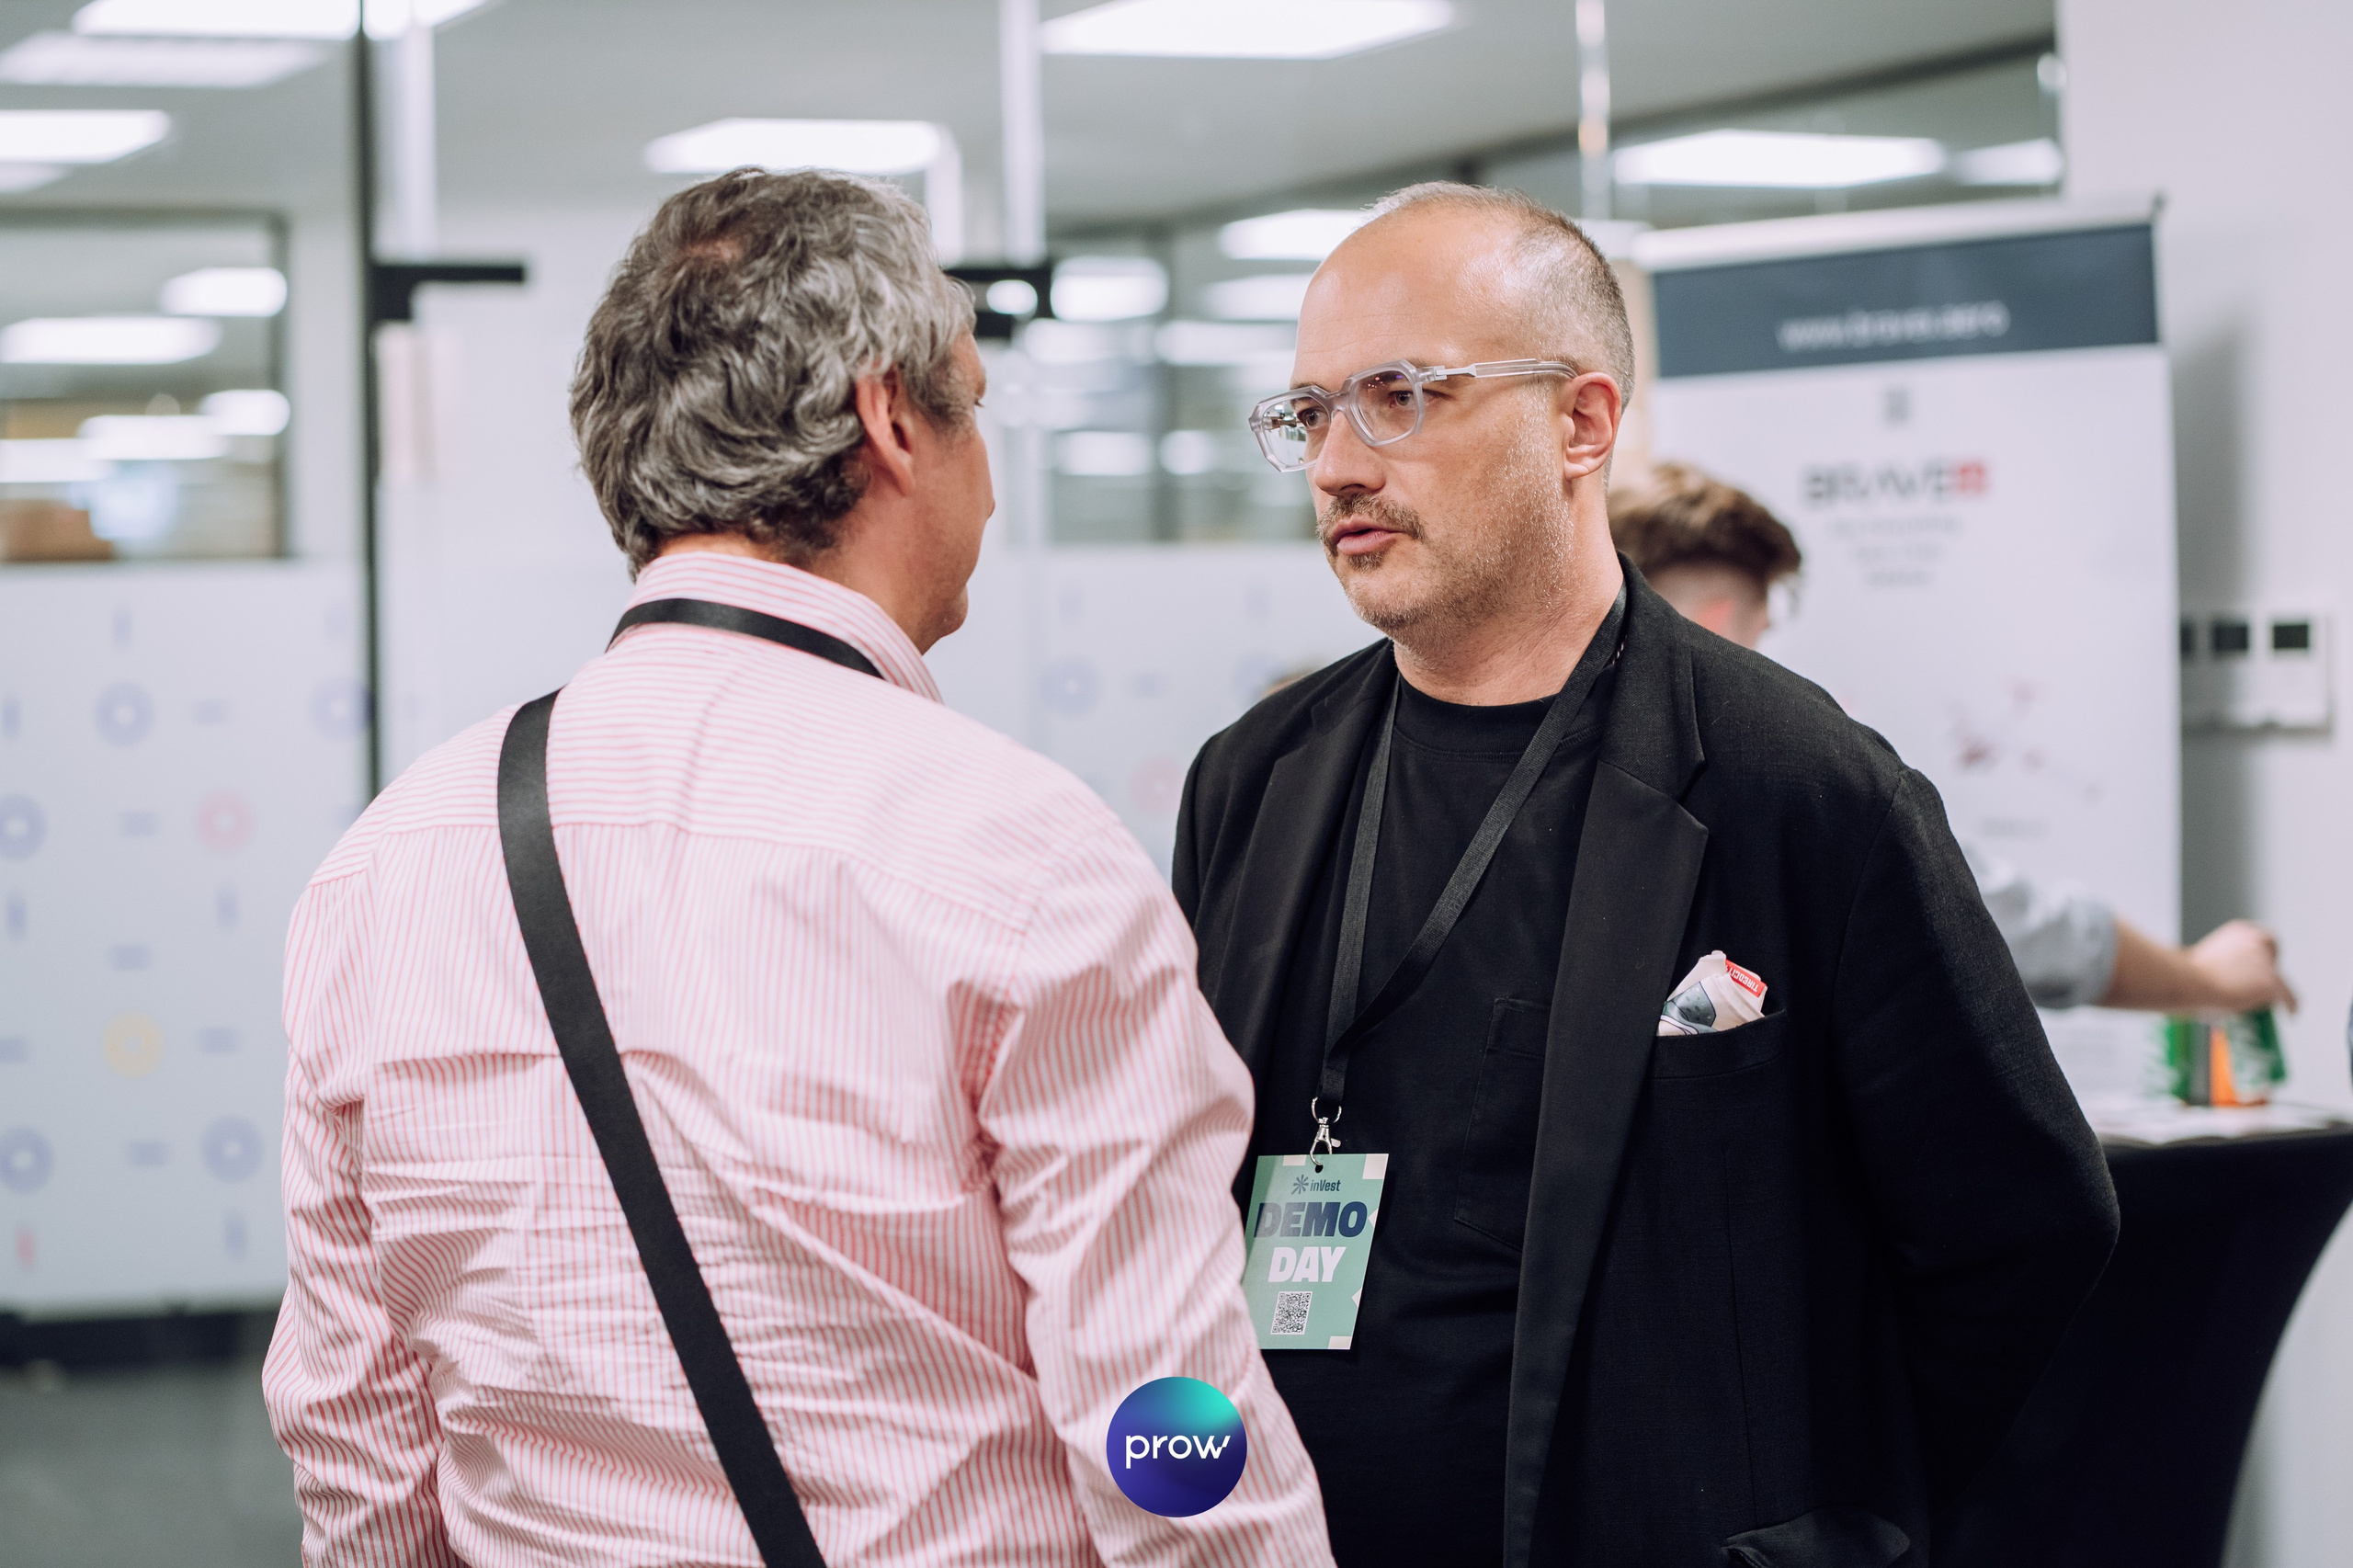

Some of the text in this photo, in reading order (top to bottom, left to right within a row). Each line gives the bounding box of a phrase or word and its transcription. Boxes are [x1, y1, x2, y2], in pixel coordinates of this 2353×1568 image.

[1310, 1179, 1341, 1192] inVest
[1254, 1201, 1368, 1238] DEMO
[1267, 1246, 1347, 1283] DAY
